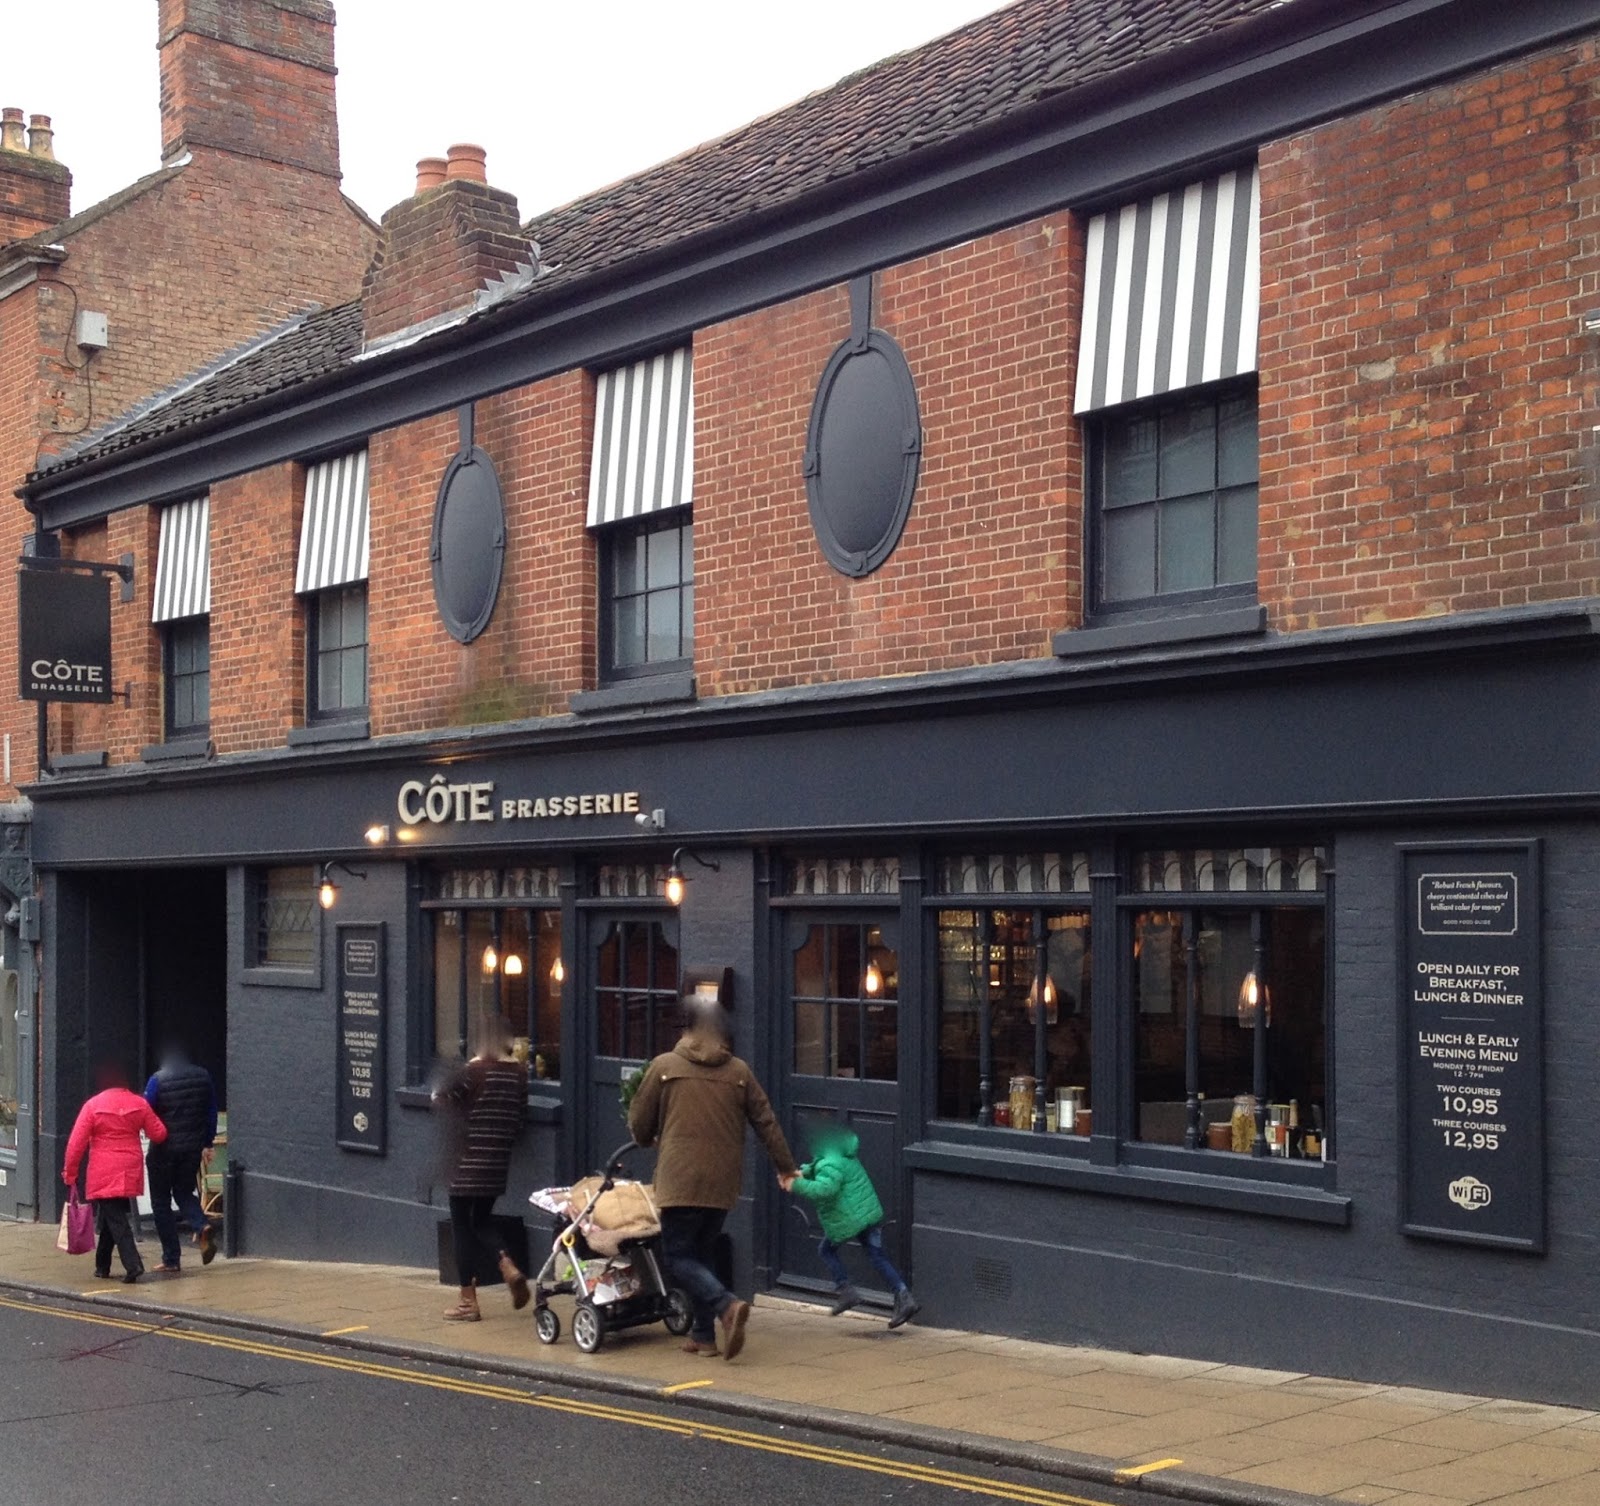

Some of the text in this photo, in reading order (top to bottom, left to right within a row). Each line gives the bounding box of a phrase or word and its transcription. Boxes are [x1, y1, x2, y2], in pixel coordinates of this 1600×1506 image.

[31, 658, 102, 682] CÔTE
[32, 682, 103, 693] BRASSERIE
[398, 774, 639, 824] CÔTE BRASSERIE
[1496, 891, 1508, 899] and
[1470, 903, 1480, 912] for
[1418, 962, 1520, 976] OPEN DAILY FOR
[1430, 977, 1507, 991] BREAKFAST,
[1414, 990, 1523, 1005] LUNCH & DINNER
[1418, 1032, 1520, 1047] LUNCH & EARLY
[1420, 1045, 1519, 1062] EVENING MENU
[1433, 1062, 1464, 1071] MONDAY
[1437, 1084, 1501, 1096] TWO COURSES
[1443, 1097, 1498, 1116] 10,95
[1432, 1119, 1507, 1132] THREE COURSES
[1444, 1130, 1499, 1150] 12,95
